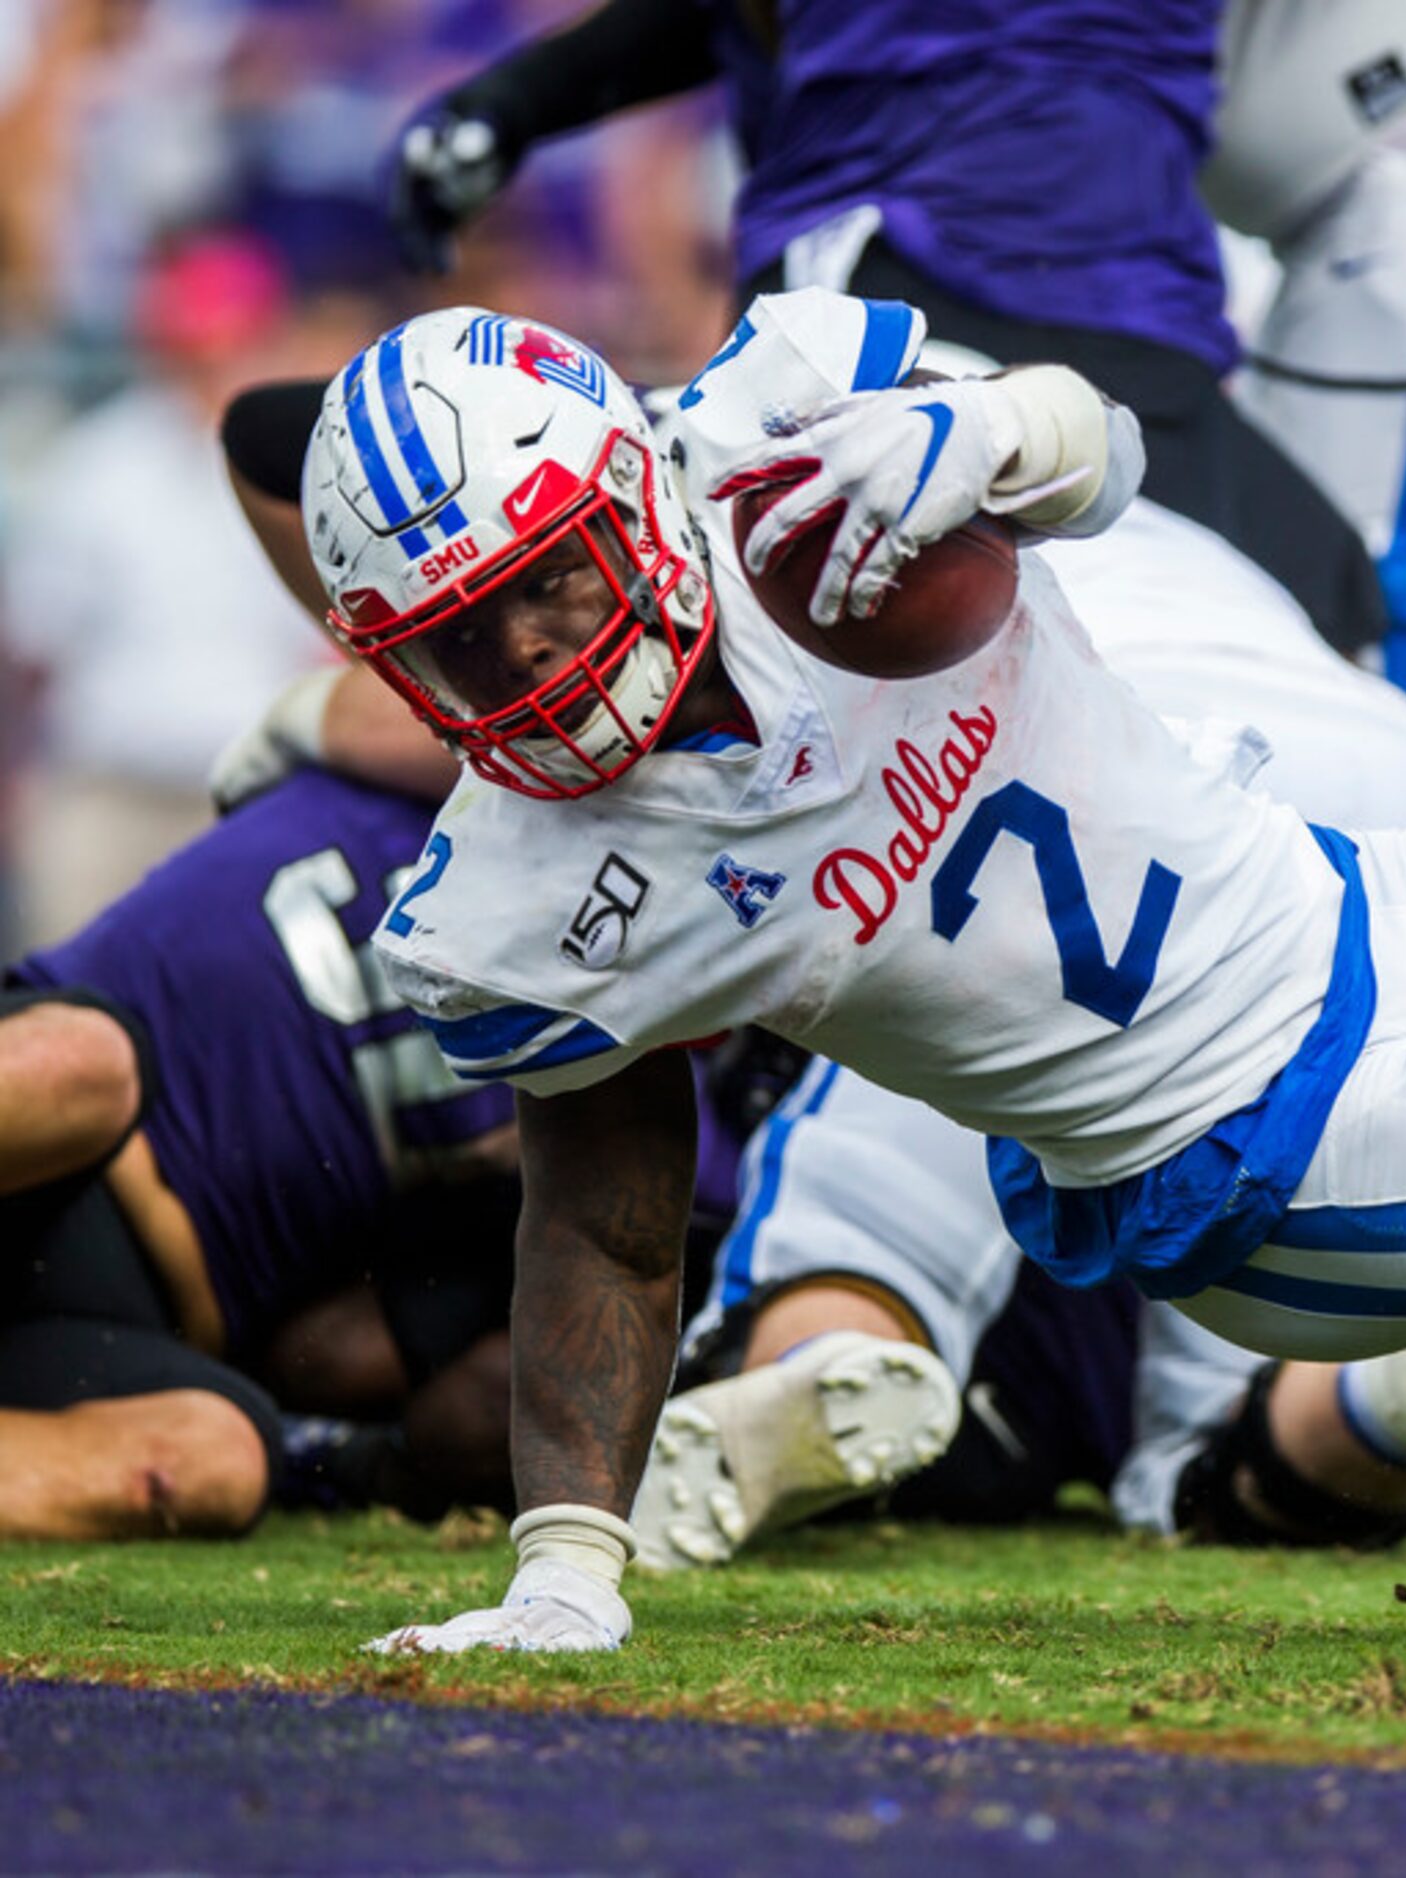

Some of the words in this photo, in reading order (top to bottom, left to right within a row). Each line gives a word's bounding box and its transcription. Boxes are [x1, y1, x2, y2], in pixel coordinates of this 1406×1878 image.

[419, 535, 480, 585] SMU
[812, 703, 998, 946] Dallas
[384, 830, 453, 939] 2
[560, 851, 651, 965] 150
[930, 777, 1183, 1029] 2
